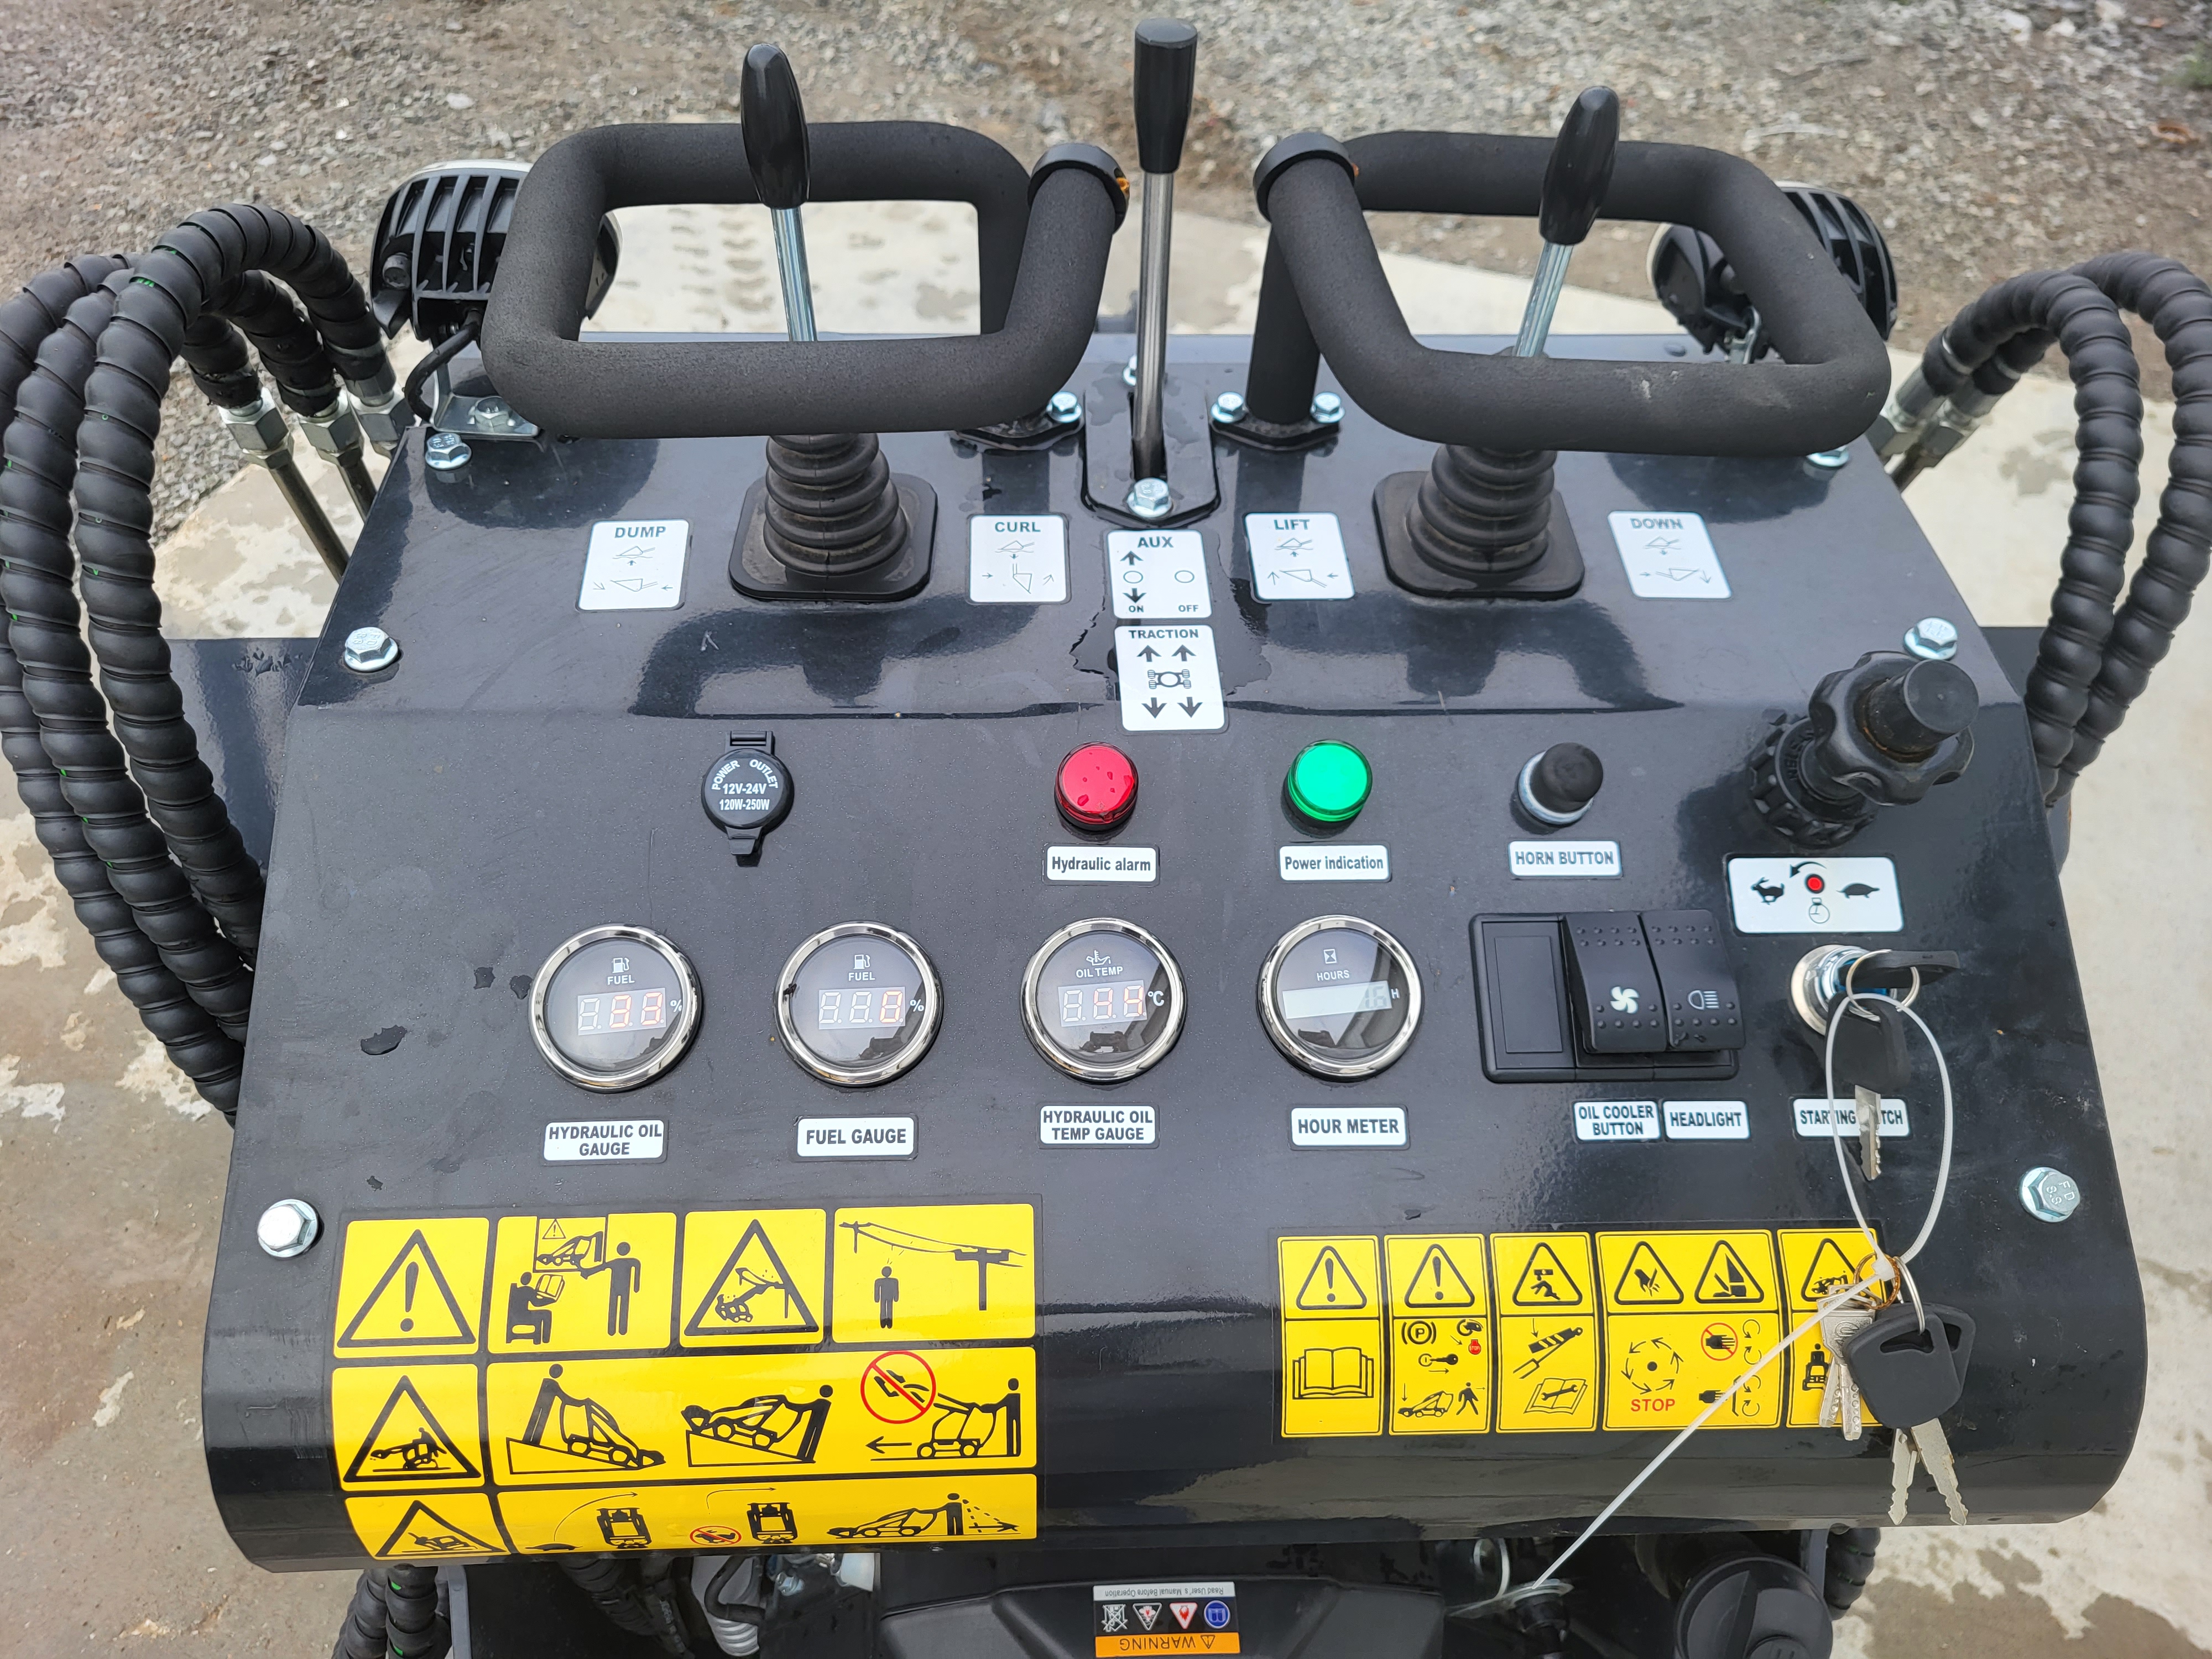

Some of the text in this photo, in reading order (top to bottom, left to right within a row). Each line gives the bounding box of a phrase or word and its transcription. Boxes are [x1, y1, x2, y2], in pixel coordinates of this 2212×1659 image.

[995, 521, 1040, 533] CURL
[1274, 519, 1310, 530] LIFT
[1630, 518, 1683, 529] DOWN
[614, 526, 666, 538] DUMP
[1138, 536, 1173, 548] AUX
[1128, 629, 1199, 639] TRACTION
[711, 759, 778, 790] POWER OUTLET
[723, 783, 766, 795] 12V-24V
[719, 799, 770, 810] 120W-250W
[1052, 856, 1151, 873] Hydraulic alarm
[1285, 855, 1384, 870] Power indication
[1515, 851, 1614, 865] HORN BUTTON
[848, 972, 875, 981] FUEL
[1076, 966, 1123, 978] OIL TEMP
[1317, 970, 1350, 981] HOURS
[607, 974, 635, 985] FUEL
[1391, 988, 1400, 999] H
[1043, 1110, 1152, 1123] HYDRAULIC OIL
[1578, 1105, 1653, 1120] OIL COOLER
[1670, 1112, 1741, 1126] HEADLIGHT
[549, 1125, 661, 1140] HYDRAULIC OIL
[1298, 1119, 1400, 1134] HOUR METER
[1593, 1121, 1644, 1136] BUTTON
[806, 1128, 906, 1145] FUEL GAUGE
[1051, 1127, 1144, 1140] TEMP GAUGE
[579, 1142, 630, 1156] GAUGE
[1630, 1399, 1676, 1412] STOP
[1105, 1588, 1136, 1597] Operation
[1119, 1636, 1196, 1651] WARNING
